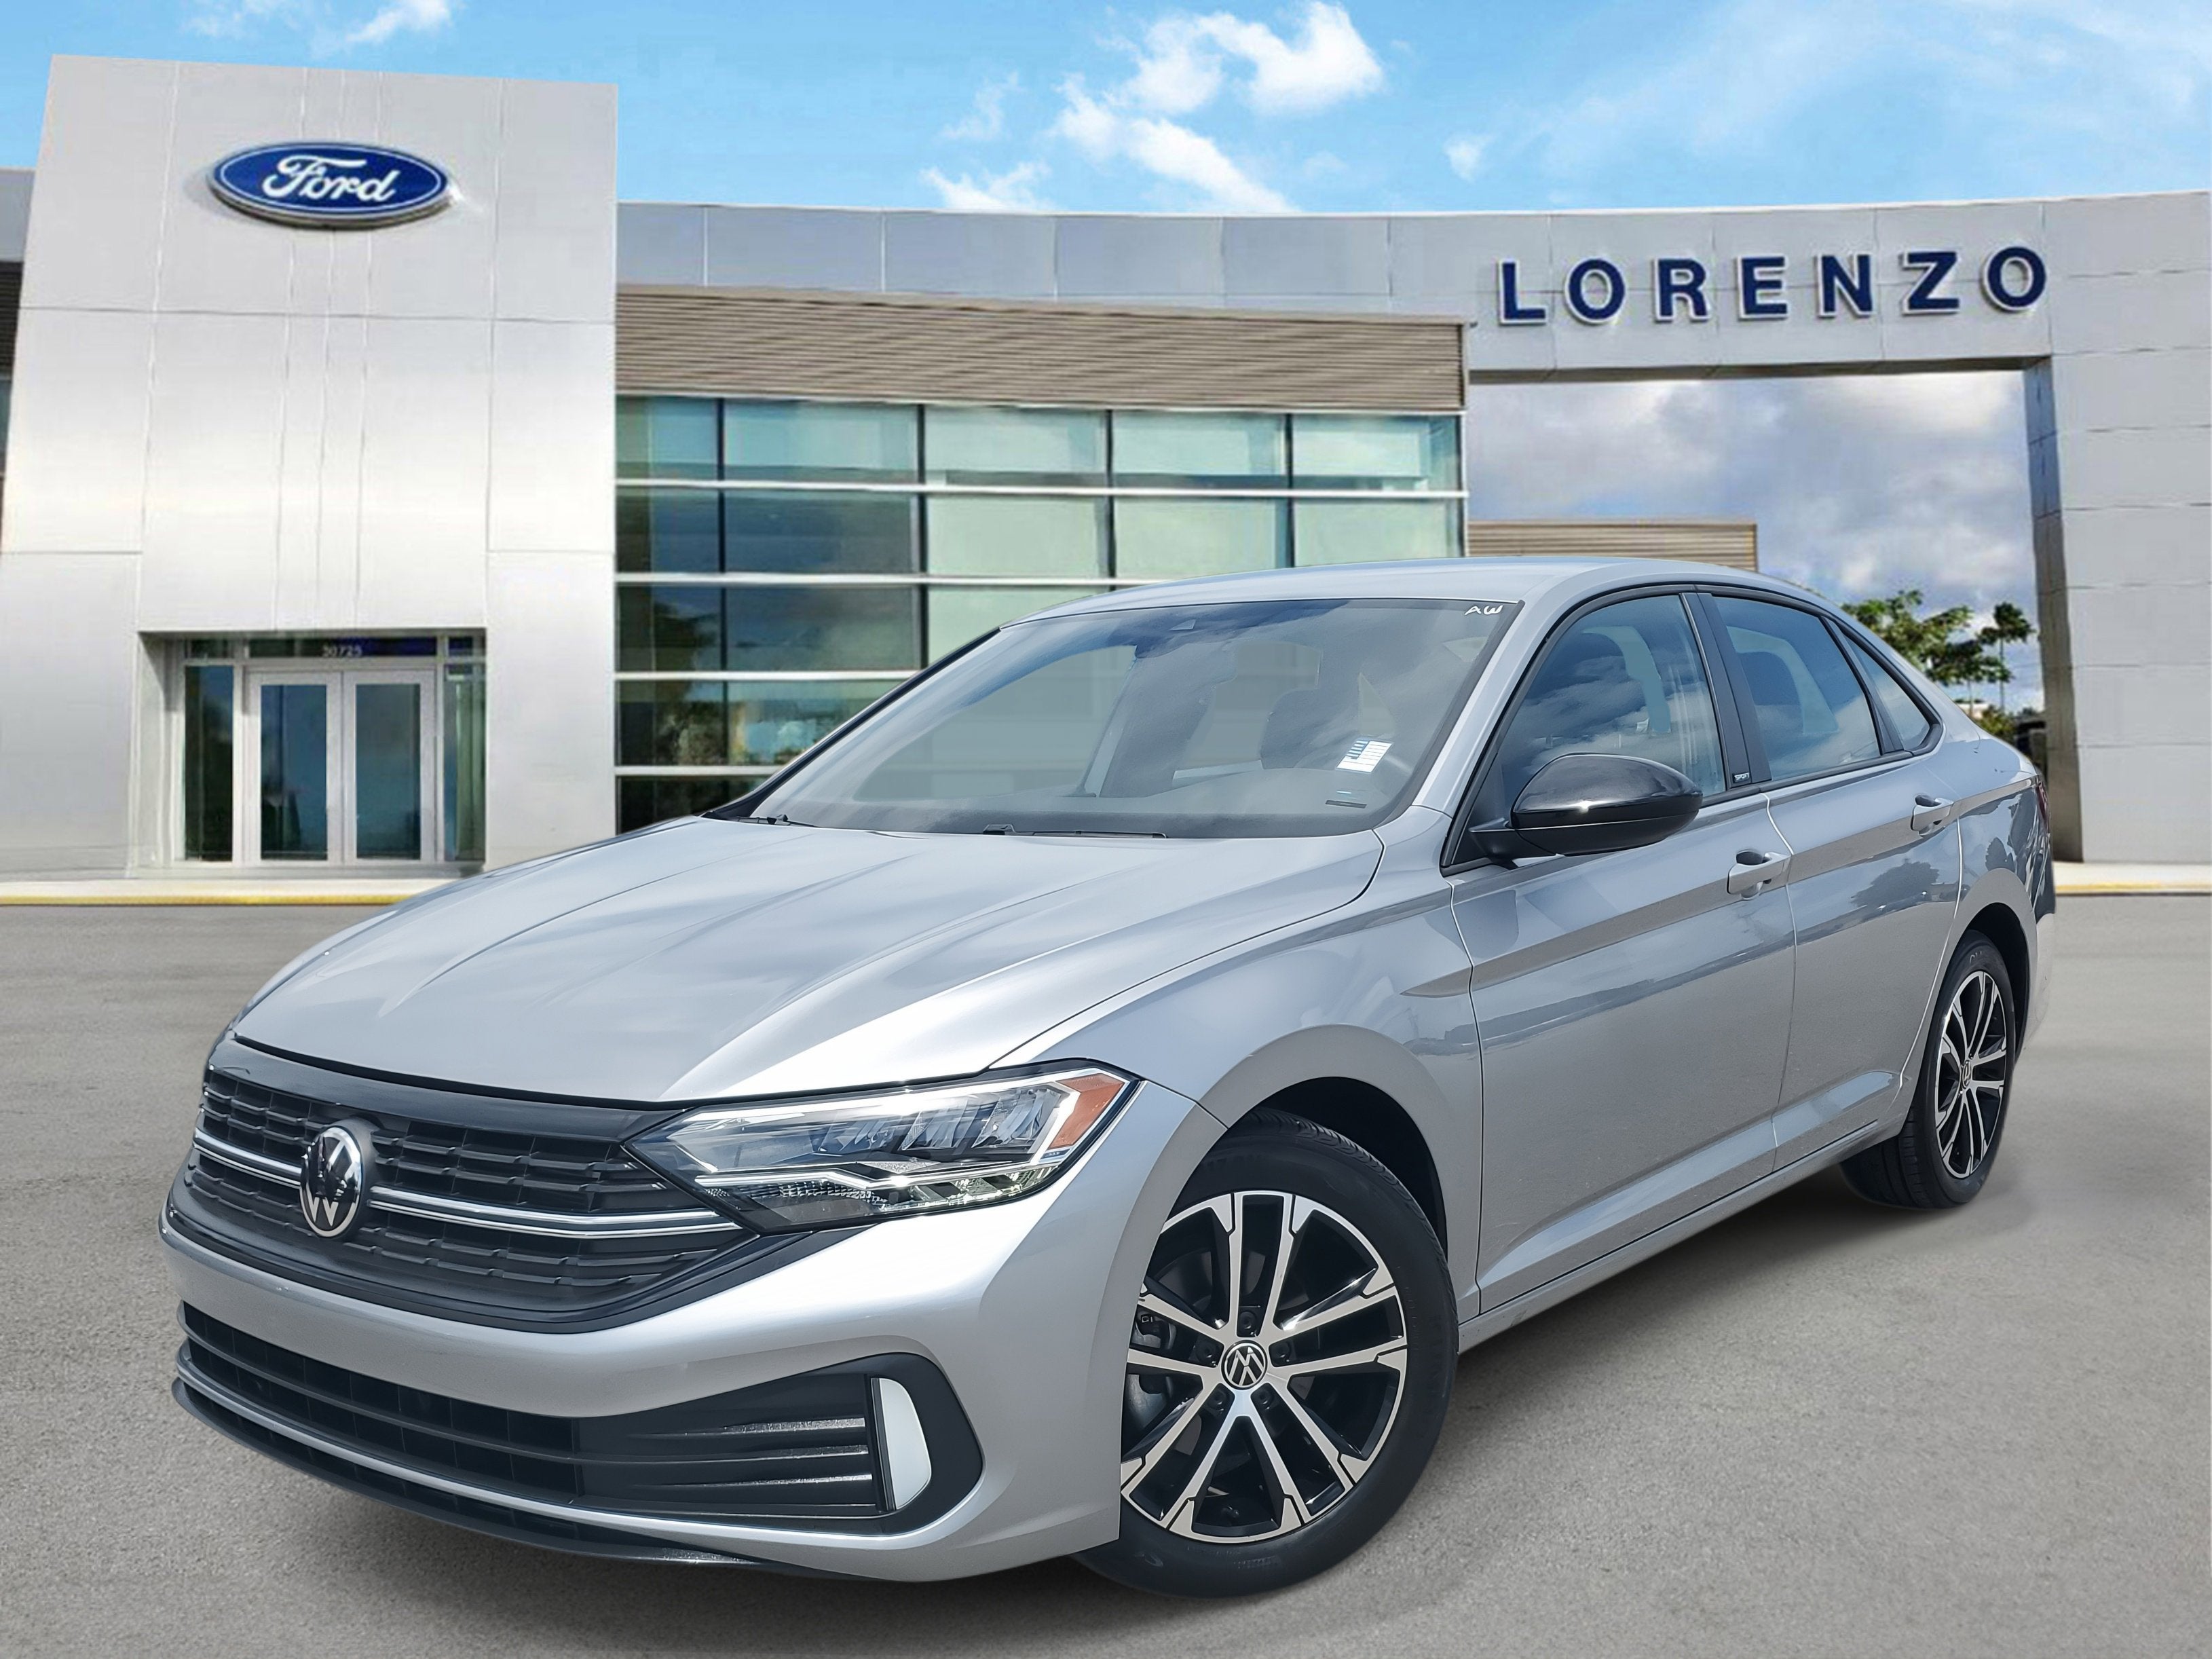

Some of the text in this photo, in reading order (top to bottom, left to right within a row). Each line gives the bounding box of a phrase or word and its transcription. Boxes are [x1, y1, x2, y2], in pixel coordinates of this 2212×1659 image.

[261, 153, 401, 202] Ford
[1499, 246, 2048, 322] LORENZO
[1464, 605, 1503, 616] AW
